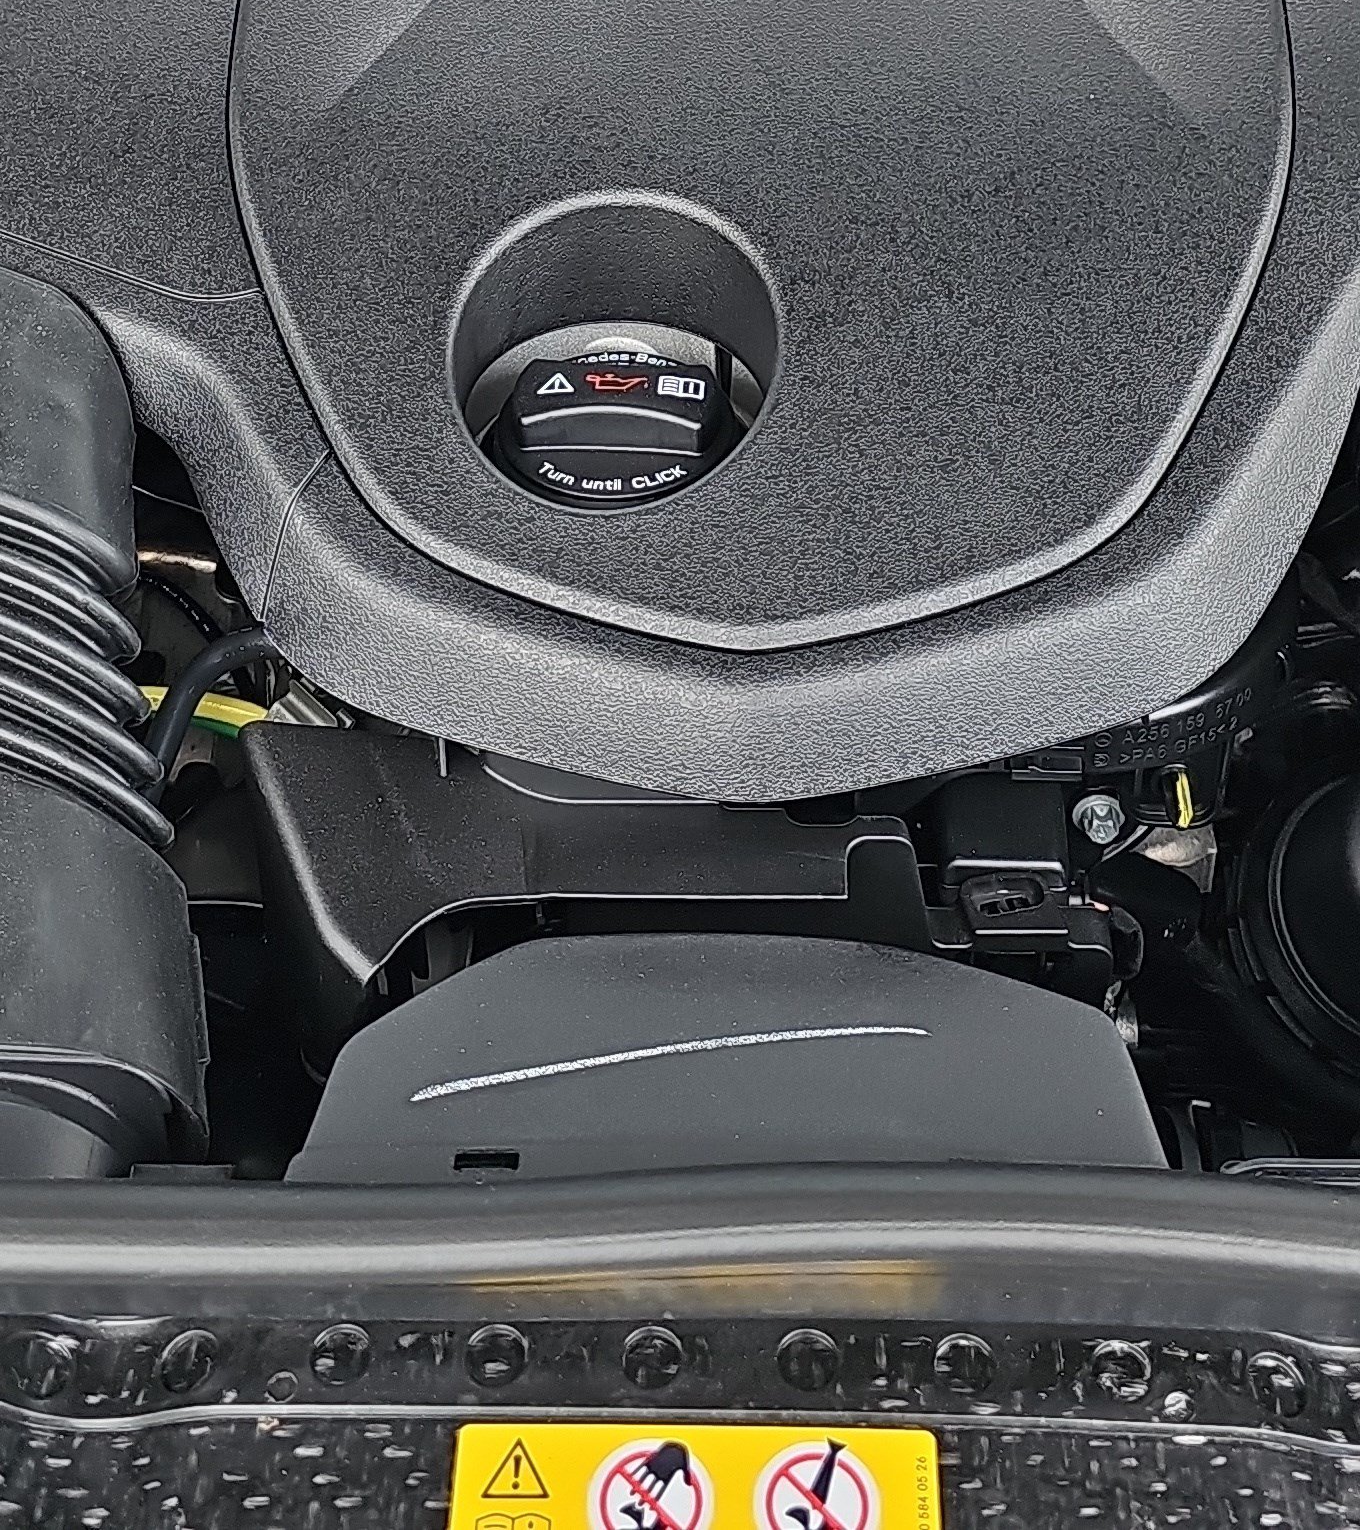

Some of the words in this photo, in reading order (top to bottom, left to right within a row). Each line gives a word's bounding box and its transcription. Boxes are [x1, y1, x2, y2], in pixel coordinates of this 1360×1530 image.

[538, 461, 575, 487] Turn
[581, 477, 623, 491] until
[631, 464, 688, 489] CLICK
[916, 1456, 927, 1471] 26
[917, 1476, 928, 1491] 05
[918, 1497, 930, 1519] 584
